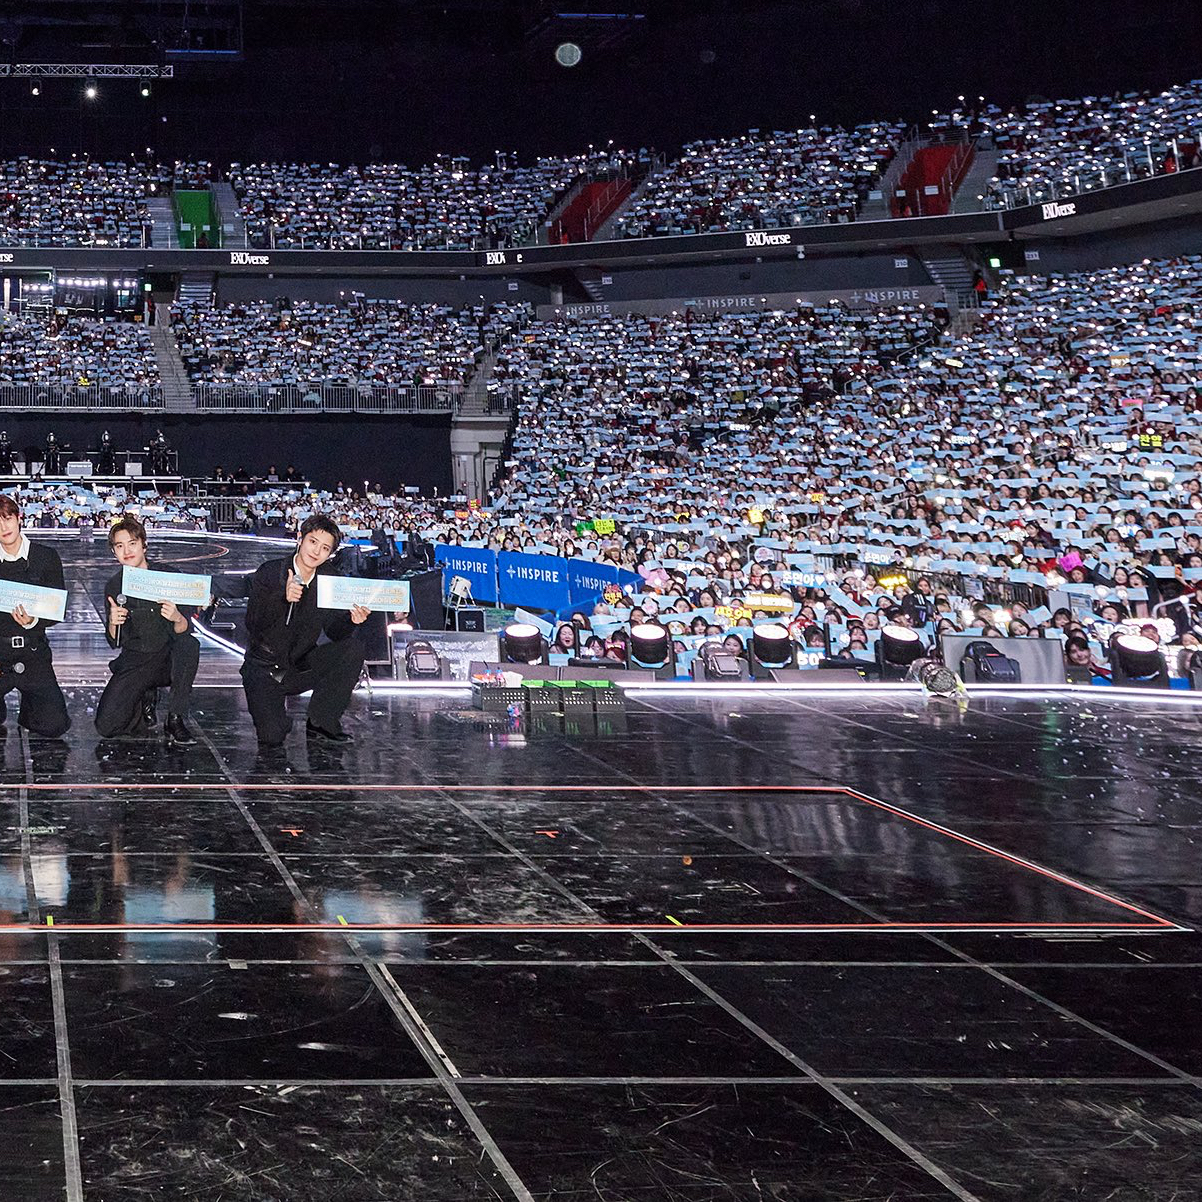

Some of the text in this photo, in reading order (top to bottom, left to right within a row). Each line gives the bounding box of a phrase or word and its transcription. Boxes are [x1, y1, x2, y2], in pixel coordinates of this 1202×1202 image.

[707, 298, 755, 309] INSPIRE
[452, 559, 488, 574] INSPIRE
[518, 566, 559, 583] INSPIRE
